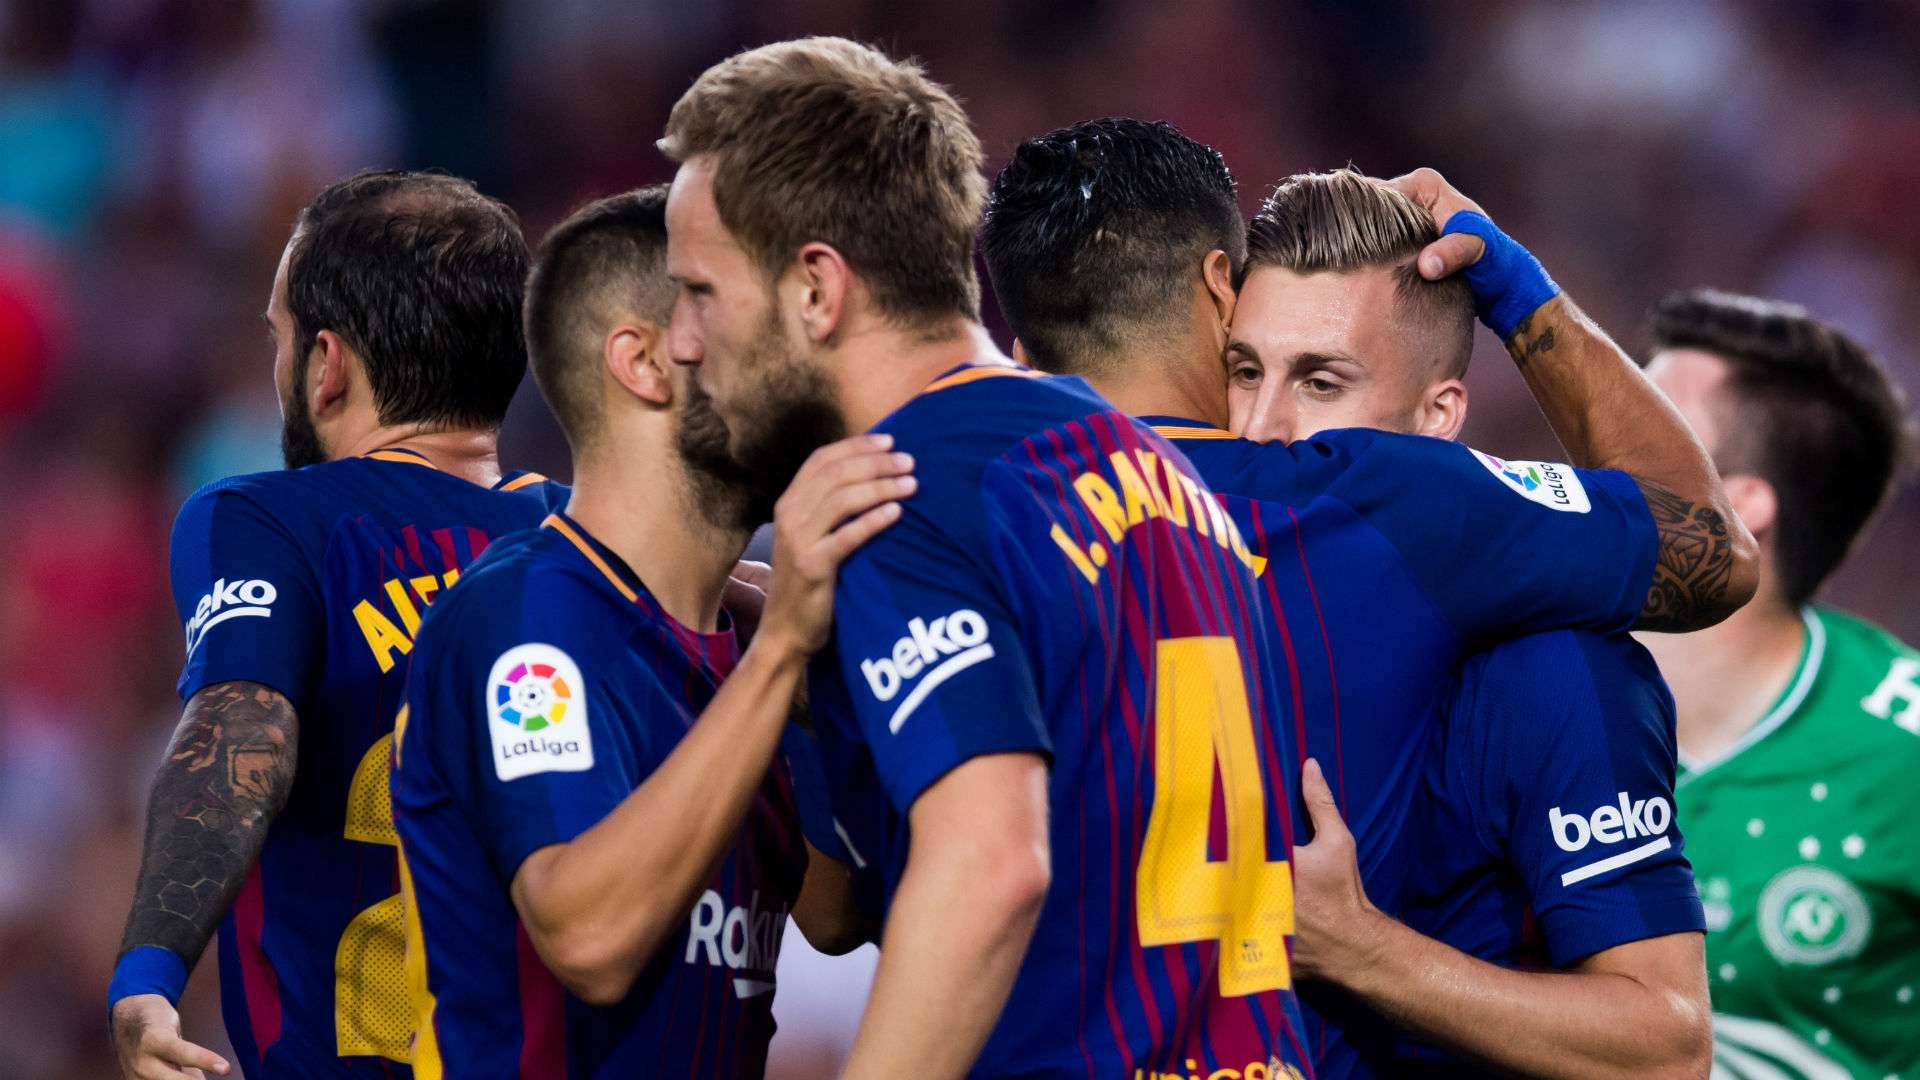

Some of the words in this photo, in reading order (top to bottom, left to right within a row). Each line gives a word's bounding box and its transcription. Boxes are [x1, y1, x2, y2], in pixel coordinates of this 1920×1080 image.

[1541, 463, 1571, 505] LaLiga
[185, 578, 277, 654] beko
[860, 609, 989, 702] beko
[502, 737, 580, 760] LaLiga
[1136, 636, 1296, 998] 4
[1549, 791, 1671, 852] beko
